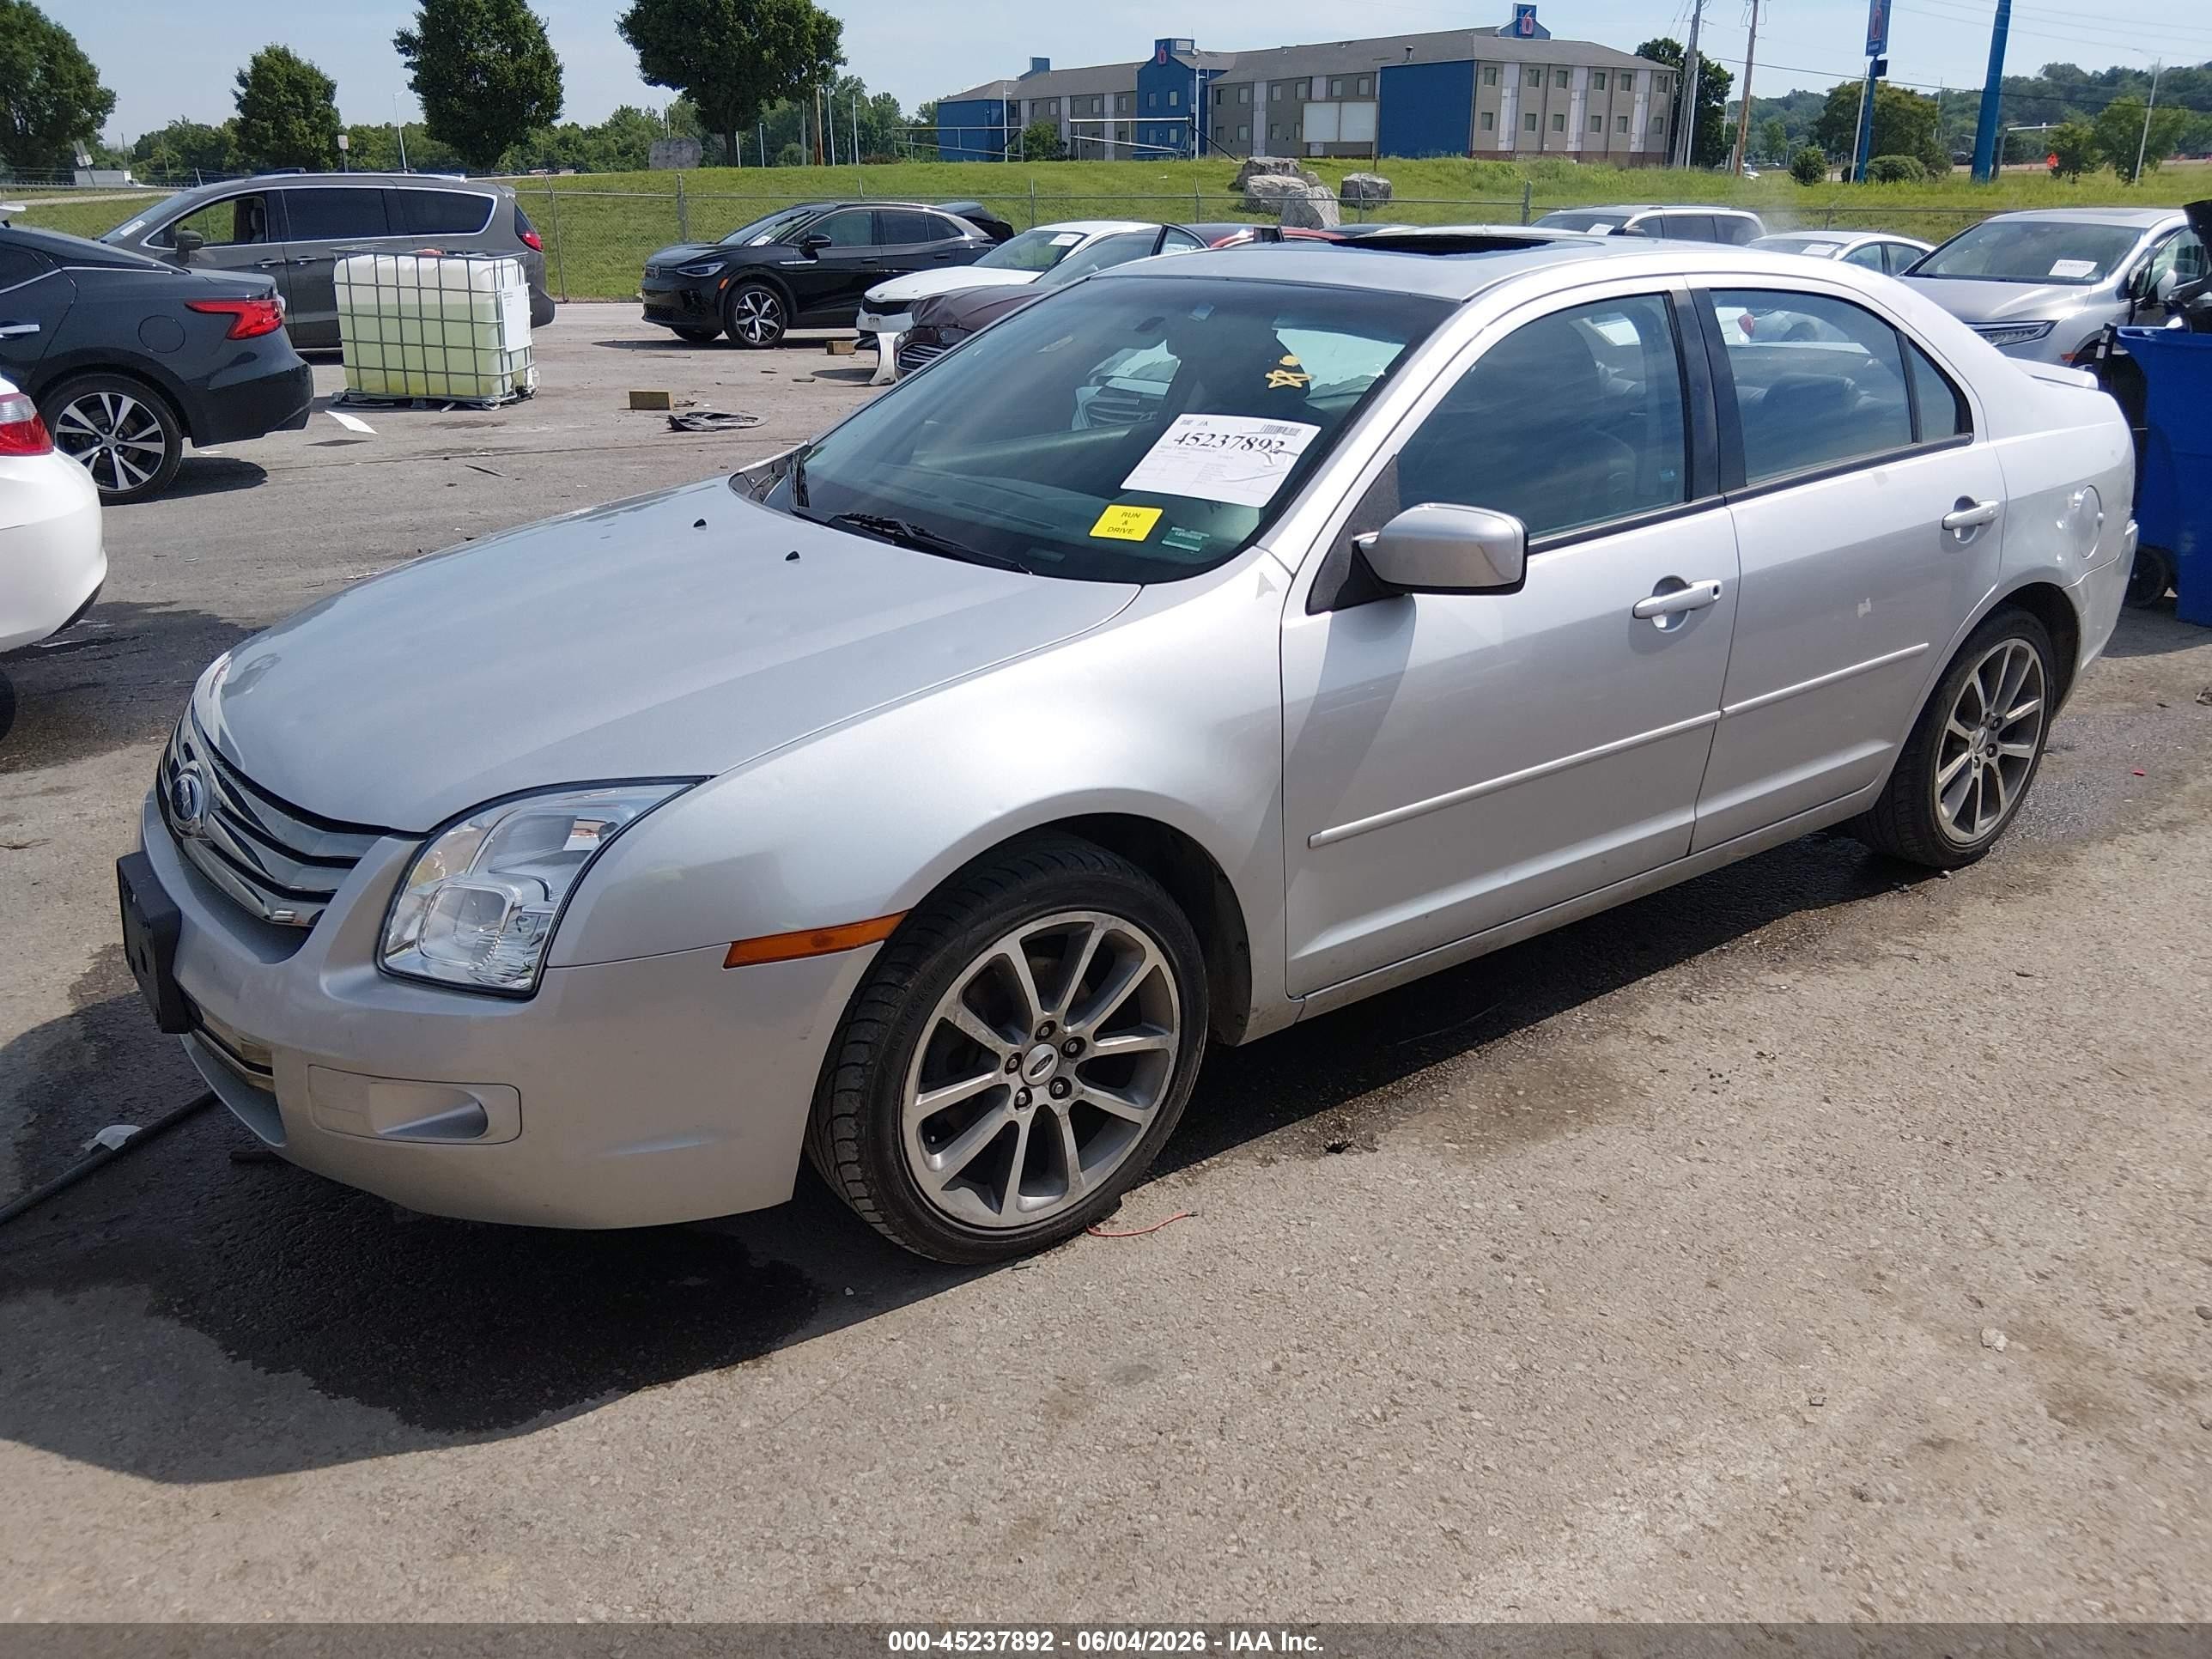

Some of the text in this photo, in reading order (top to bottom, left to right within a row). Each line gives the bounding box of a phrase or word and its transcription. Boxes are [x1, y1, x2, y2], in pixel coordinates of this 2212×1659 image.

[1522, 9, 1534, 35] 6
[1158, 43, 1167, 65] 6
[1174, 432, 1285, 454] 45237892
